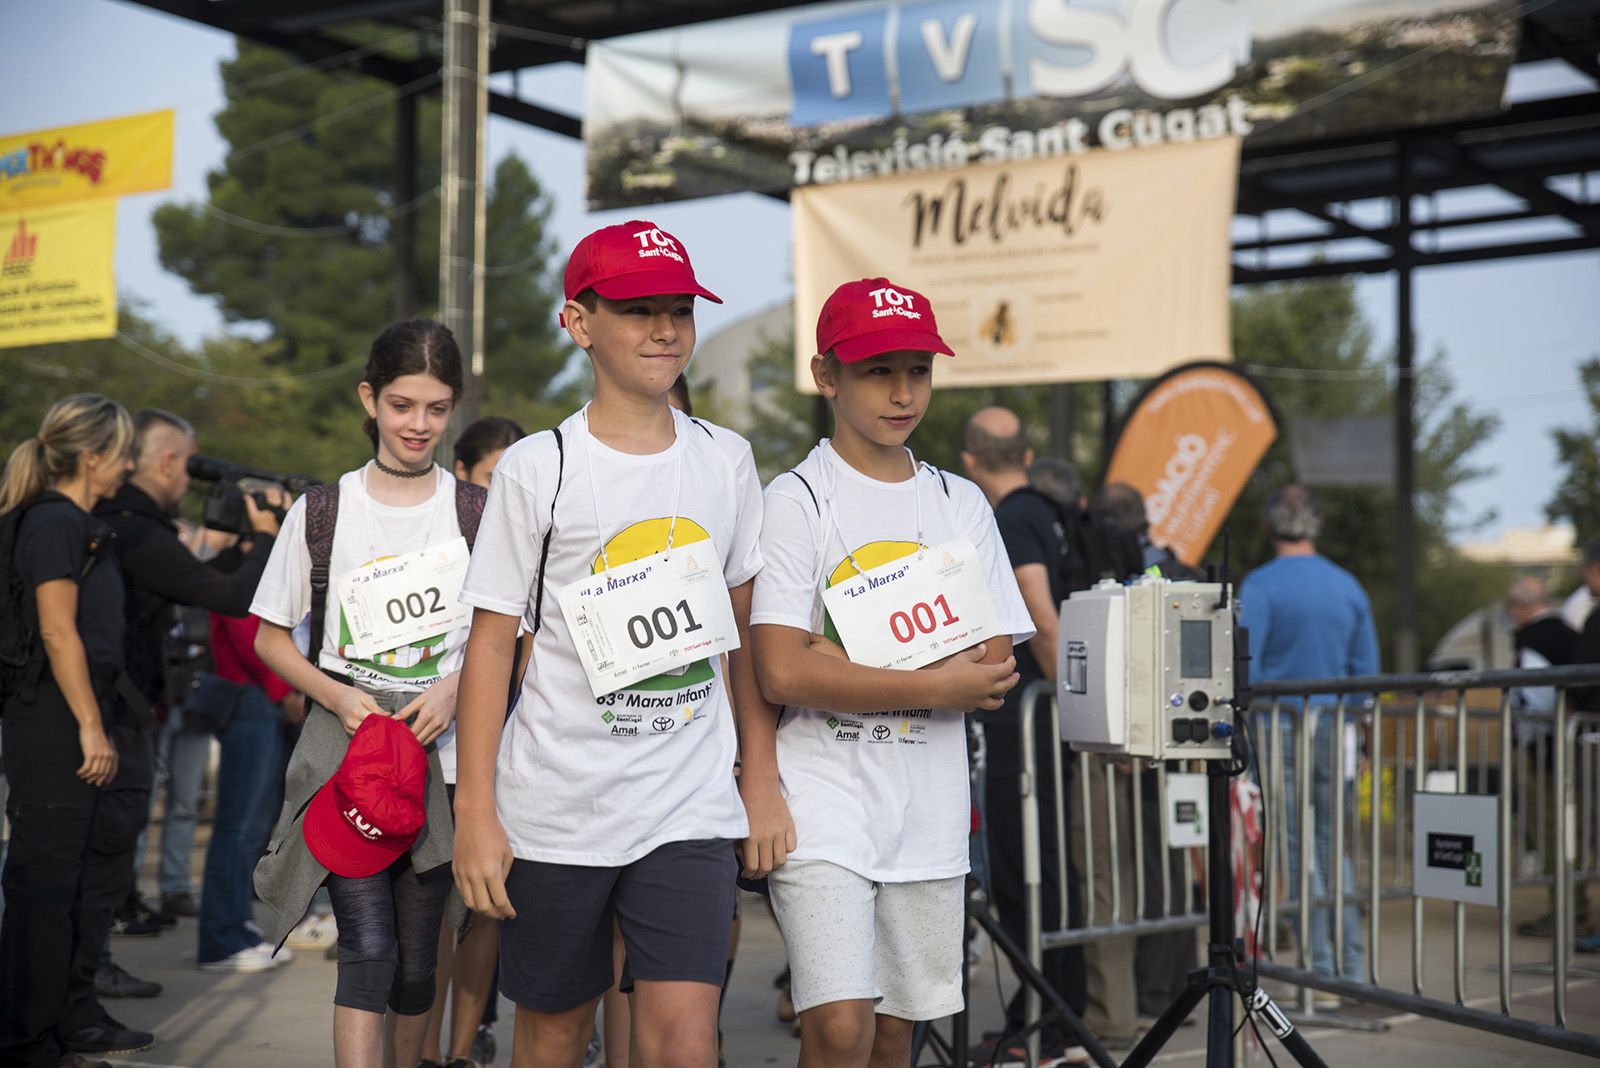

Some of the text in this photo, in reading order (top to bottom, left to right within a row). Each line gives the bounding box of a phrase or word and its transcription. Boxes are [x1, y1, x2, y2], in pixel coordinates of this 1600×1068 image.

[979, 116, 1091, 166] Sant
[905, 160, 1108, 249] Melvida
[633, 228, 678, 251] TOT
[638, 247, 661, 258] Sant
[868, 287, 915, 310] TOT
[872, 306, 894, 319] Sant
[386, 586, 447, 625] 002
[626, 599, 703, 650] 001
[889, 593, 960, 645] 001
[626, 693, 674, 708] Marxa
[836, 729, 860, 740] Amat
